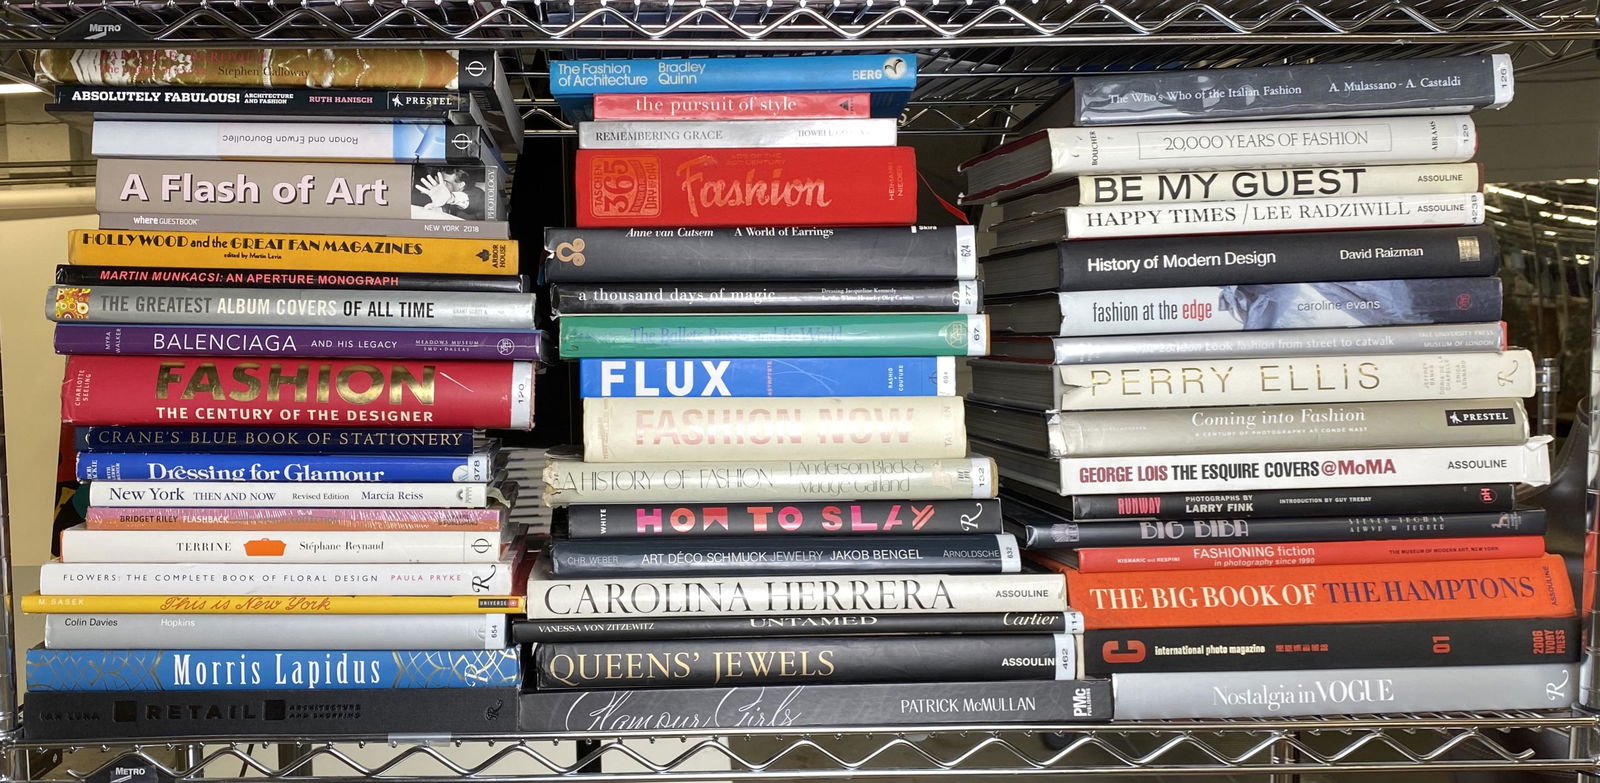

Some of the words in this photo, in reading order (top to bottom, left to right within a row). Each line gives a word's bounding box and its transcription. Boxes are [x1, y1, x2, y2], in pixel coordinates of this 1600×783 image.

[89, 23, 121, 33] METRO
[658, 62, 706, 75] Bradley
[852, 69, 883, 80] BERG
[72, 91, 161, 102] ABSOLUTELY
[164, 92, 240, 103] FABULOUS!
[334, 96, 374, 104] HANISCH
[405, 96, 452, 106] PRESTEL
[1109, 94, 1128, 104] The
[1132, 92, 1163, 103] Who's
[1167, 90, 1192, 101] Who
[1195, 90, 1206, 99] of
[1209, 89, 1226, 99] the
[1229, 87, 1260, 98] Italian
[1264, 85, 1302, 96] Fashion
[636, 96, 664, 111] the
[671, 96, 735, 116] pursuit
[738, 96, 755, 112] of
[760, 96, 798, 116] style
[222, 133, 273, 144] Bouroullec
[275, 135, 303, 145] Erwan
[307, 135, 327, 144] and
[328, 135, 359, 145] Ronan
[1163, 136, 1224, 152] 20,000
[1227, 133, 1275, 149] YEARS
[1278, 132, 1299, 147] OF
[1303, 130, 1369, 146] FASHION
[1094, 175, 1144, 203] BE
[1158, 172, 1219, 201] MY
[1232, 167, 1367, 198] GUEST
[1417, 173, 1464, 183] ASSOULINE
[119, 172, 150, 202] A
[161, 172, 261, 204] Flash
[272, 174, 315, 205] of
[325, 176, 389, 206] Art
[487, 169, 496, 220] PHOTOLOGY
[1417, 203, 1465, 213] ASSOULINE
[424, 224, 440, 232] NEW
[442, 224, 460, 232] YORK
[463, 224, 480, 233] 2018
[625, 227, 653, 238] Anne
[655, 228, 674, 238] van
[677, 227, 714, 238] Cutsem
[82, 233, 189, 248] HOLLYWOOD
[190, 236, 210, 249] and
[212, 236, 228, 249] the
[229, 237, 286, 250] GREAT
[288, 240, 321, 252] FAN
[322, 240, 424, 255] MAGAZINES
[960, 244, 971, 258] 624
[1088, 256, 1141, 273] History
[1143, 255, 1159, 269] of
[1163, 253, 1221, 268] Modern
[1224, 250, 1277, 267] Design
[99, 270, 149, 281] MARTIN
[151, 271, 224, 283] MUNKACSI:
[226, 272, 244, 283] AN
[246, 272, 314, 285] APERTURE
[317, 275, 399, 286] MONOGRAPH
[100, 295, 129, 312] THE
[135, 296, 213, 314] GREATEST
[217, 297, 270, 315] ALBUM
[276, 298, 337, 316] COVERS
[343, 300, 362, 317] OF
[368, 301, 393, 318] ALL
[398, 301, 435, 318] TIME
[1093, 301, 1138, 322] fashion
[1143, 301, 1154, 321] at
[1158, 300, 1178, 320] the
[1182, 298, 1213, 321] edge
[153, 333, 297, 351] BALENCIAGA
[311, 339, 333, 348] AND
[337, 339, 354, 348] HIS
[358, 340, 398, 349] LEGACY
[82, 372, 92, 402] SEELING
[155, 361, 436, 406] FASHION
[600, 360, 732, 396] FLUX
[1090, 366, 1234, 397] PERRY
[1260, 361, 1380, 393] ELLIS
[75, 369, 85, 407] CHARLOTTE
[635, 408, 802, 445] FASHION
[818, 407, 915, 444] NOW
[1192, 411, 1257, 429] Coming
[1261, 410, 1295, 425] into
[1300, 408, 1366, 424] Fashion
[1463, 412, 1509, 422] PRESTEL
[98, 431, 180, 444] CRANE'S
[190, 431, 237, 445] BLUE
[245, 432, 300, 445] BOOK
[307, 432, 331, 445] OF
[339, 432, 463, 446] STATIONERY
[146, 463, 246, 481] Dressing
[248, 462, 281, 481] for
[283, 463, 385, 482] Glamour
[473, 459, 481, 481] 378
[1447, 459, 1507, 470] ASSOULINE
[109, 488, 146, 501] New
[149, 487, 184, 501] York
[193, 492, 223, 501] THEN
[223, 492, 247, 501] AND
[250, 492, 276, 501] NOW
[292, 492, 321, 501] Revised
[323, 492, 349, 501] Edition
[361, 490, 396, 501] Marcia
[398, 490, 424, 501] Reiss
[1117, 496, 1161, 515] RUNWAY
[1185, 503, 1223, 513] LARRY
[1227, 502, 1254, 513] FINK
[120, 514, 155, 523] BRIDGET
[156, 515, 178, 523] RILEY
[182, 514, 229, 524] FLASHBACK
[636, 507, 729, 533] HOW
[747, 505, 803, 531] TO
[821, 503, 936, 531] SLAY
[1140, 521, 1185, 540] BIG
[1194, 519, 1249, 539] BIBA
[1214, 559, 1222, 567] in
[1223, 557, 1274, 569] photography
[1275, 557, 1297, 566] since
[1298, 557, 1316, 565] 1990
[995, 589, 1049, 599] ASSOULINE
[1089, 587, 1149, 610] THE
[1150, 586, 1199, 609] BIG
[1200, 584, 1280, 608] BOOK
[1281, 583, 1317, 607] OF
[1322, 581, 1381, 604] THE
[1381, 576, 1535, 602] HAMPTONS
[1542, 565, 1558, 607] ASSOULINE
[545, 581, 751, 615] CAROLINA
[764, 579, 956, 612] HERRERA
[64, 618, 88, 627] Colin
[89, 618, 118, 627] Davies
[161, 618, 196, 628] Hopkins
[538, 624, 581, 633] VANESSA
[584, 623, 605, 632] VON
[606, 622, 655, 631] ZITZEWITZ
[1544, 629, 1555, 654] IVORY
[1555, 629, 1566, 654] PRESS
[173, 653, 261, 685] Morris
[275, 653, 381, 689] Lapidus
[549, 652, 699, 687] QUEENS'
[713, 648, 836, 685] JEWELS
[1213, 684, 1295, 711] Nostalgia
[1298, 684, 1316, 704] in
[1315, 677, 1395, 704] VOGUE
[901, 697, 959, 714] PATRICK
[962, 696, 1036, 713] McMULLAN
